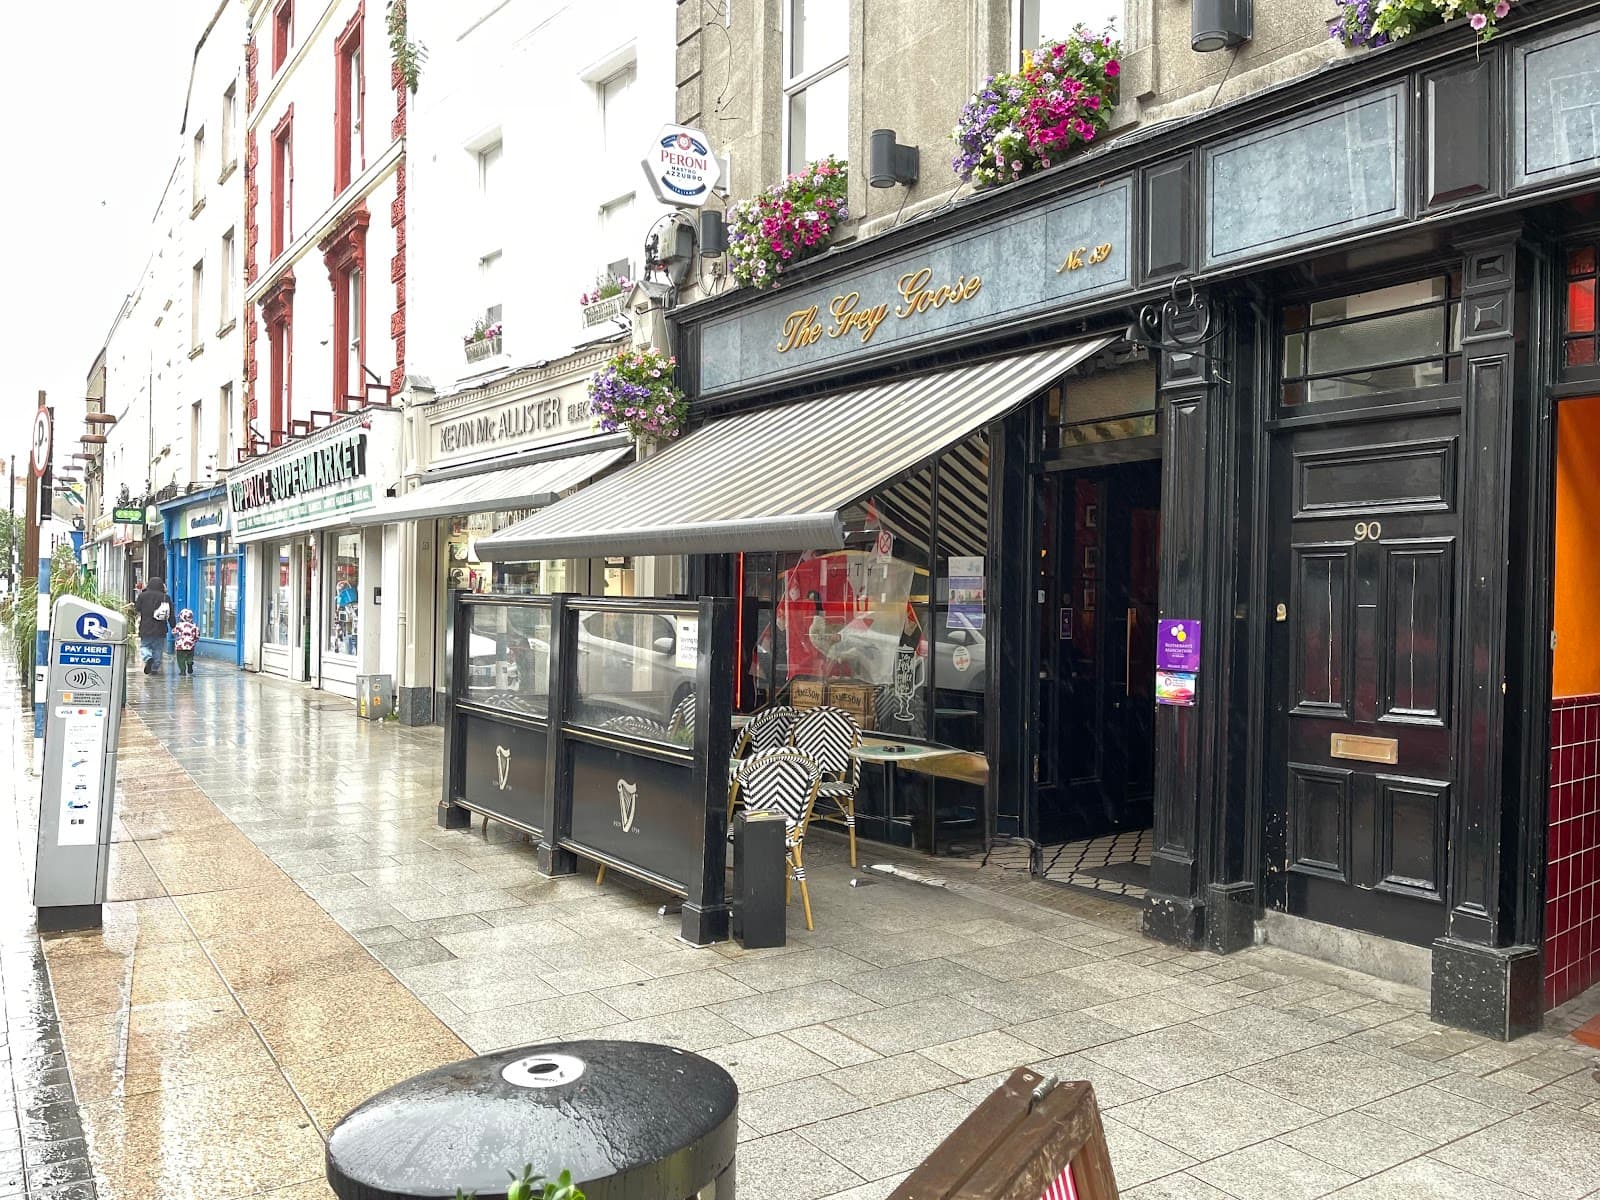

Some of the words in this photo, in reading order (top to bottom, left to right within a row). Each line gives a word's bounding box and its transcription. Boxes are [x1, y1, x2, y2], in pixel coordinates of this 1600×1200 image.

[661, 149, 707, 171] PERONI
[671, 166, 697, 175] NASTRO
[665, 170, 703, 182] AZZURRO
[1088, 242, 1113, 265] 89
[776, 304, 823, 353] The
[827, 291, 889, 344] Grey
[895, 267, 981, 318] Goose
[440, 418, 475, 453] KEVIN
[498, 397, 562, 440] ALLISTER
[567, 400, 591, 422] ELEC
[243, 470, 272, 509] PRICE
[271, 435, 365, 502] SUPERMARKET
[1353, 521, 1382, 541] 90
[64, 645, 82, 653] PAY
[83, 646, 108, 654] HERE
